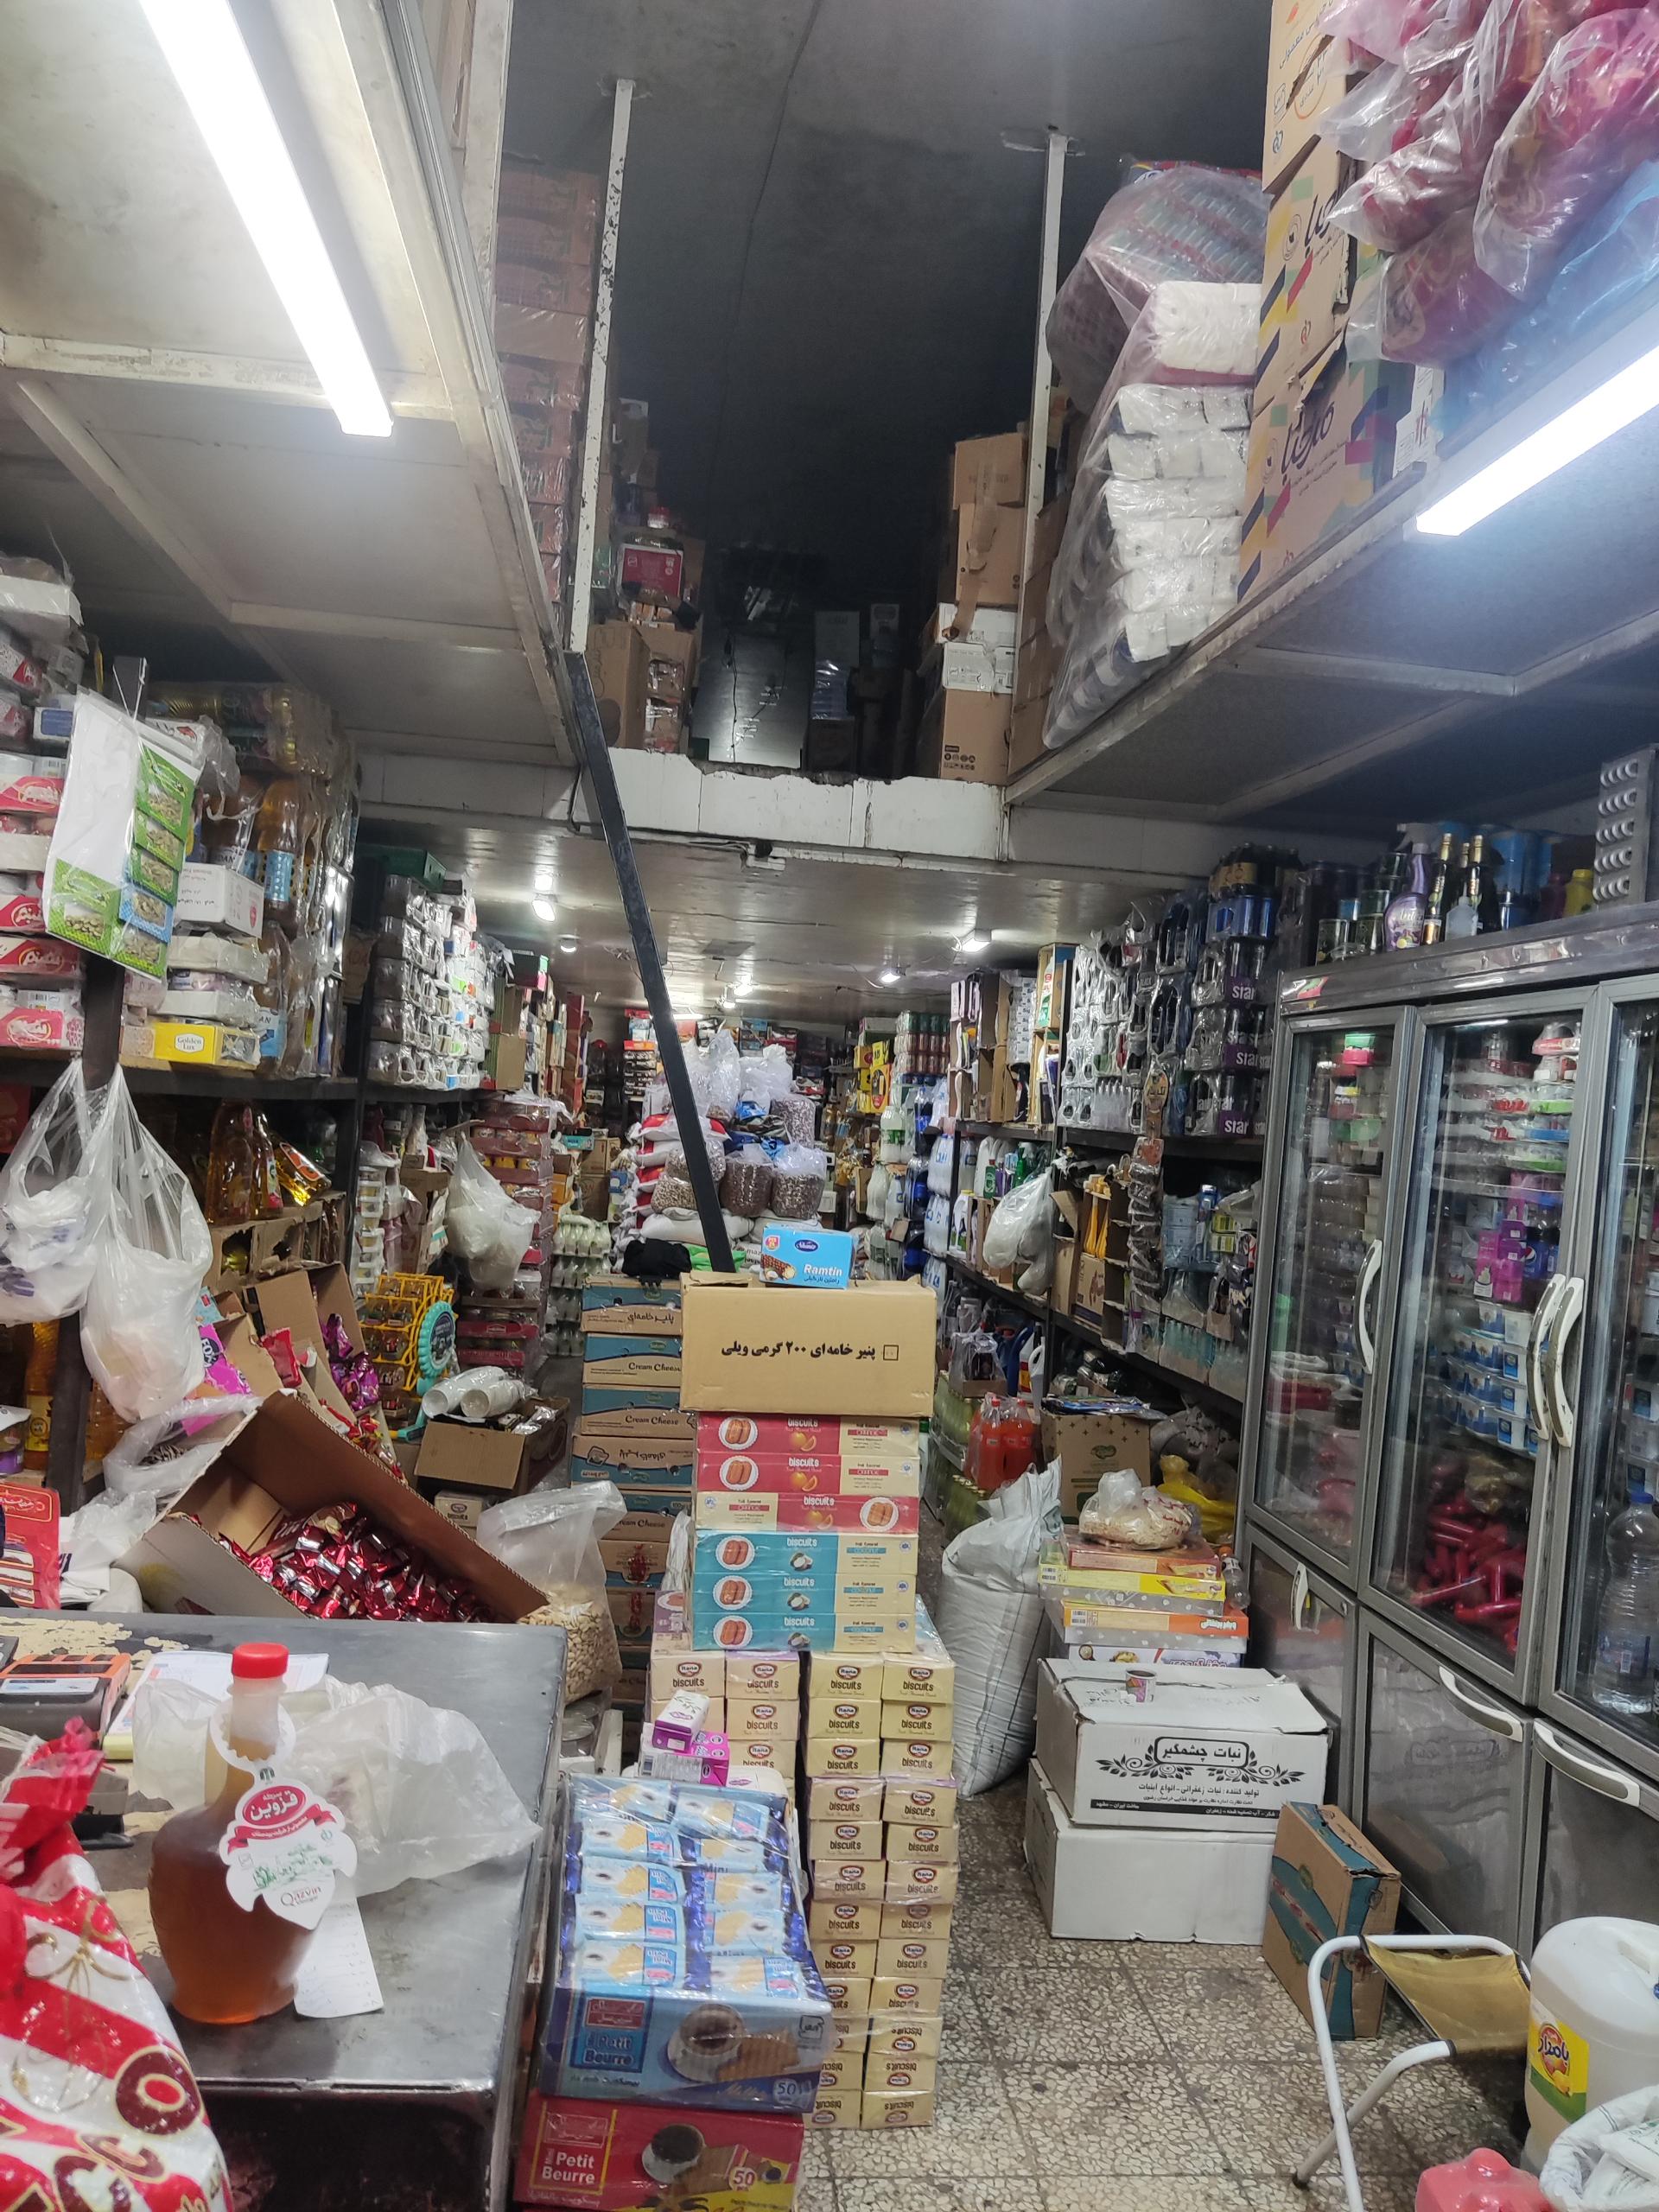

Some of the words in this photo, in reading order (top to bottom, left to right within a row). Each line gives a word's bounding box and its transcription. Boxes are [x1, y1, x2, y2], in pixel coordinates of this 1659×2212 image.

[177, 1036, 201, 1046] Golden
[1224, 1119, 1249, 1135] Star
[804, 1264, 842, 1277] Ramtin
[751, 1342, 784, 1357] گرمی
[785, 1340, 807, 1355] ۲۰۰
[855, 1344, 876, 1361] پنیر
[628, 1362, 653, 1371] Cream
[625, 1414, 649, 1423] Cream
[651, 1416, 679, 1426] Cheese
[787, 1417, 819, 1427] biscuits
[788, 1457, 820, 1467] biscuits
[803, 1495, 835, 1506] biscuits
[637, 1518, 665, 1529] Cheese
[786, 1537, 817, 1547] biscuits
[784, 1577, 815, 1586] biscuits
[784, 1617, 815, 1626] biscuits
[672, 1678, 705, 1688] biscuits
[747, 1679, 779, 1688] biscuits
[830, 1680, 861, 1690] biscuits
[903, 1681, 934, 1691] biscuits
[747, 1720, 779, 1730] biscuits
[829, 1719, 860, 1729] biscuits
[901, 1719, 932, 1730] biscuits
[1161, 1744, 1208, 1763] چشمگیر
[1213, 1746, 1242, 1763] نبات
[827, 1760, 859, 1770] biscuits
[901, 1758, 932, 1770] biscuits
[1244, 1789, 1260, 1798] تولید
[251, 1789, 299, 1821] قزوین
[829, 1802, 861, 1812] biscuits
[904, 1805, 936, 1816] biscuits
[830, 1840, 861, 1850] biscuits
[908, 1842, 939, 1853] biscuits
[705, 1863, 728, 1874] Mini
[835, 1881, 866, 1891] biscuits
[907, 1884, 938, 1894] biscuits
[829, 1920, 860, 1929] biscuits
[901, 1920, 932, 1929] biscuits
[824, 1960, 856, 1969] biscuits
[896, 1960, 928, 1969] biscuits
[583, 2050, 632, 2066] Beurre
[886, 2063, 917, 2072] biscuits
[777, 2082, 797, 2095] 50
[884, 2101, 915, 2110] biscuits
[556, 2151, 595, 2170] Petit
[541, 2166, 596, 2185] Beurre
[734, 2171, 755, 2185] 50
